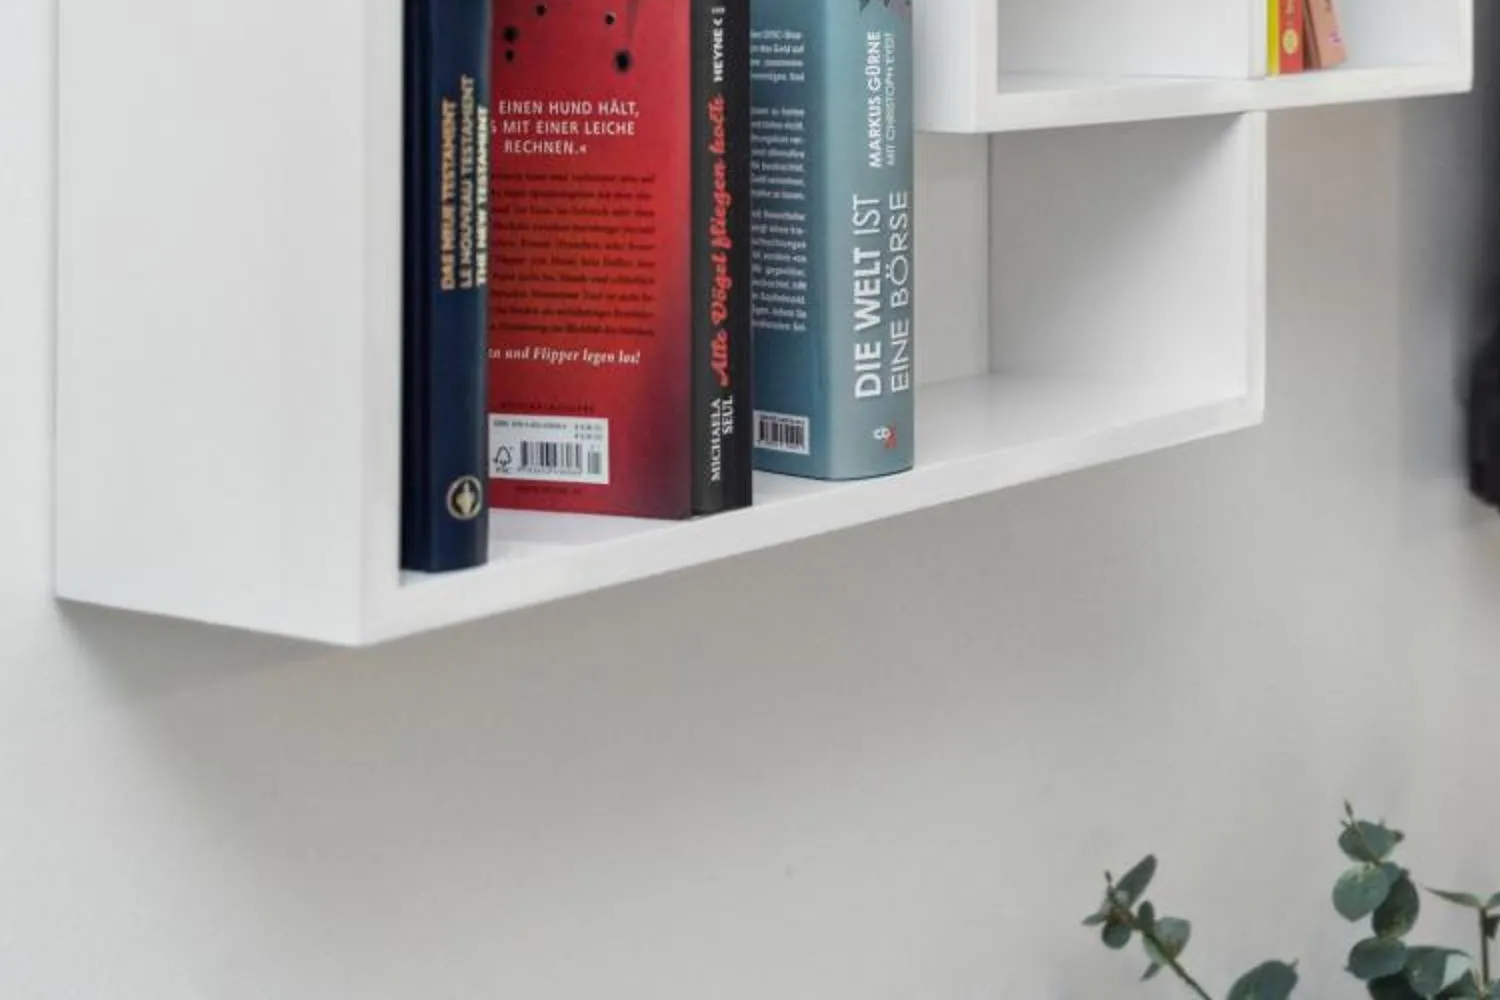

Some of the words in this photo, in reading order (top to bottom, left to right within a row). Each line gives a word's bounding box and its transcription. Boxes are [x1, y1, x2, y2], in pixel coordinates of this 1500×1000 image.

[712, 28, 725, 83] HEYNE
[865, 31, 882, 92] GÜRNE
[460, 75, 475, 176] TESTAMENT
[499, 100, 542, 115] EINEN
[549, 101, 592, 116] HUND
[599, 99, 641, 118] HÄLT,
[503, 121, 530, 133] MIT
[536, 121, 579, 135] EINER
[584, 122, 635, 136] LEICHE
[869, 95, 882, 168] MARKUS
[885, 67, 897, 141] CHRISTOPH
[441, 98, 456, 200] TESTAMENT
[477, 105, 488, 204] TESTAMENT
[886, 145, 897, 167] MIT
[441, 204, 455, 251] NEUE
[459, 180, 473, 264] NOUVEAU
[476, 209, 488, 249] NEW
[707, 157, 733, 248] fliegen
[852, 193, 881, 235] IST
[441, 255, 455, 290] DAS
[459, 267, 473, 289] LE
[476, 251, 488, 286] THE
[886, 191, 909, 308] BÖRSE
[709, 252, 733, 326] Vögel
[853, 247, 881, 332] WELT
[505, 346, 530, 360] und
[533, 346, 580, 365] Flipper
[583, 347, 615, 367] legen
[618, 349, 641, 365] los!
[708, 327, 729, 388] Alle
[855, 341, 882, 399] DIE
[891, 318, 910, 392] EINE
[711, 398, 722, 482] MICHAELA
[721, 396, 733, 434] SEUL
